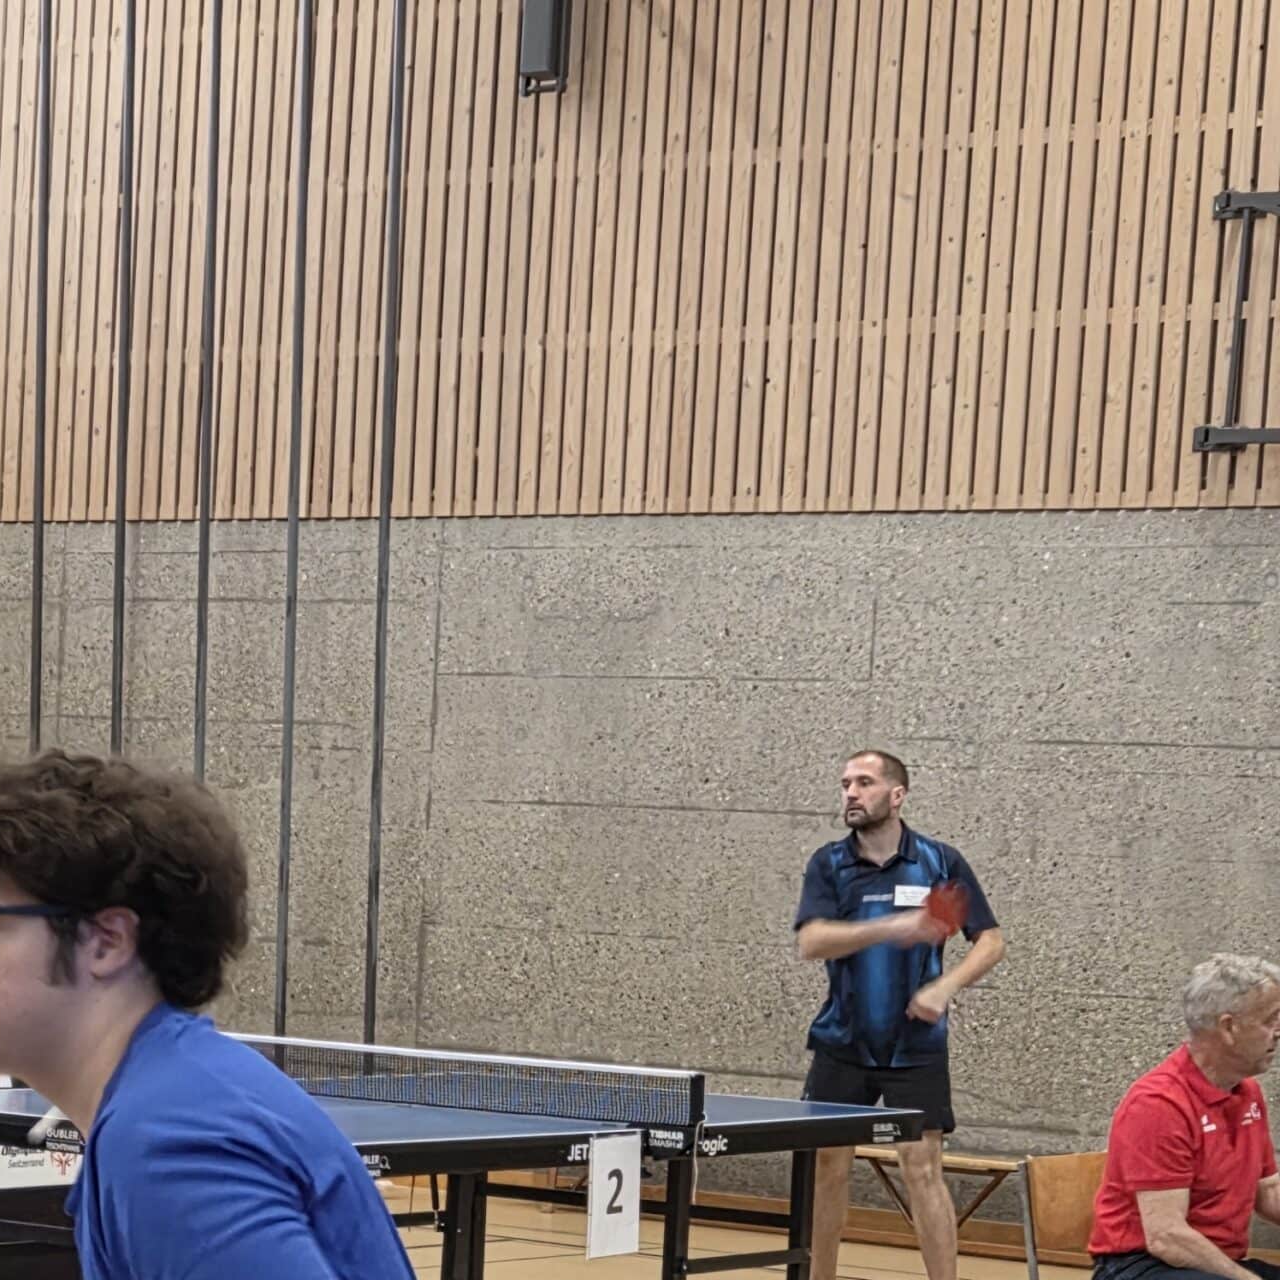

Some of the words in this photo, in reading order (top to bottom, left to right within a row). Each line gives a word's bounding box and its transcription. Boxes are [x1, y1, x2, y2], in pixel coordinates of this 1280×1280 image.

[47, 1127, 80, 1141] GUBLER
[567, 1143, 592, 1162] JET
[606, 1168, 624, 1215] 2
